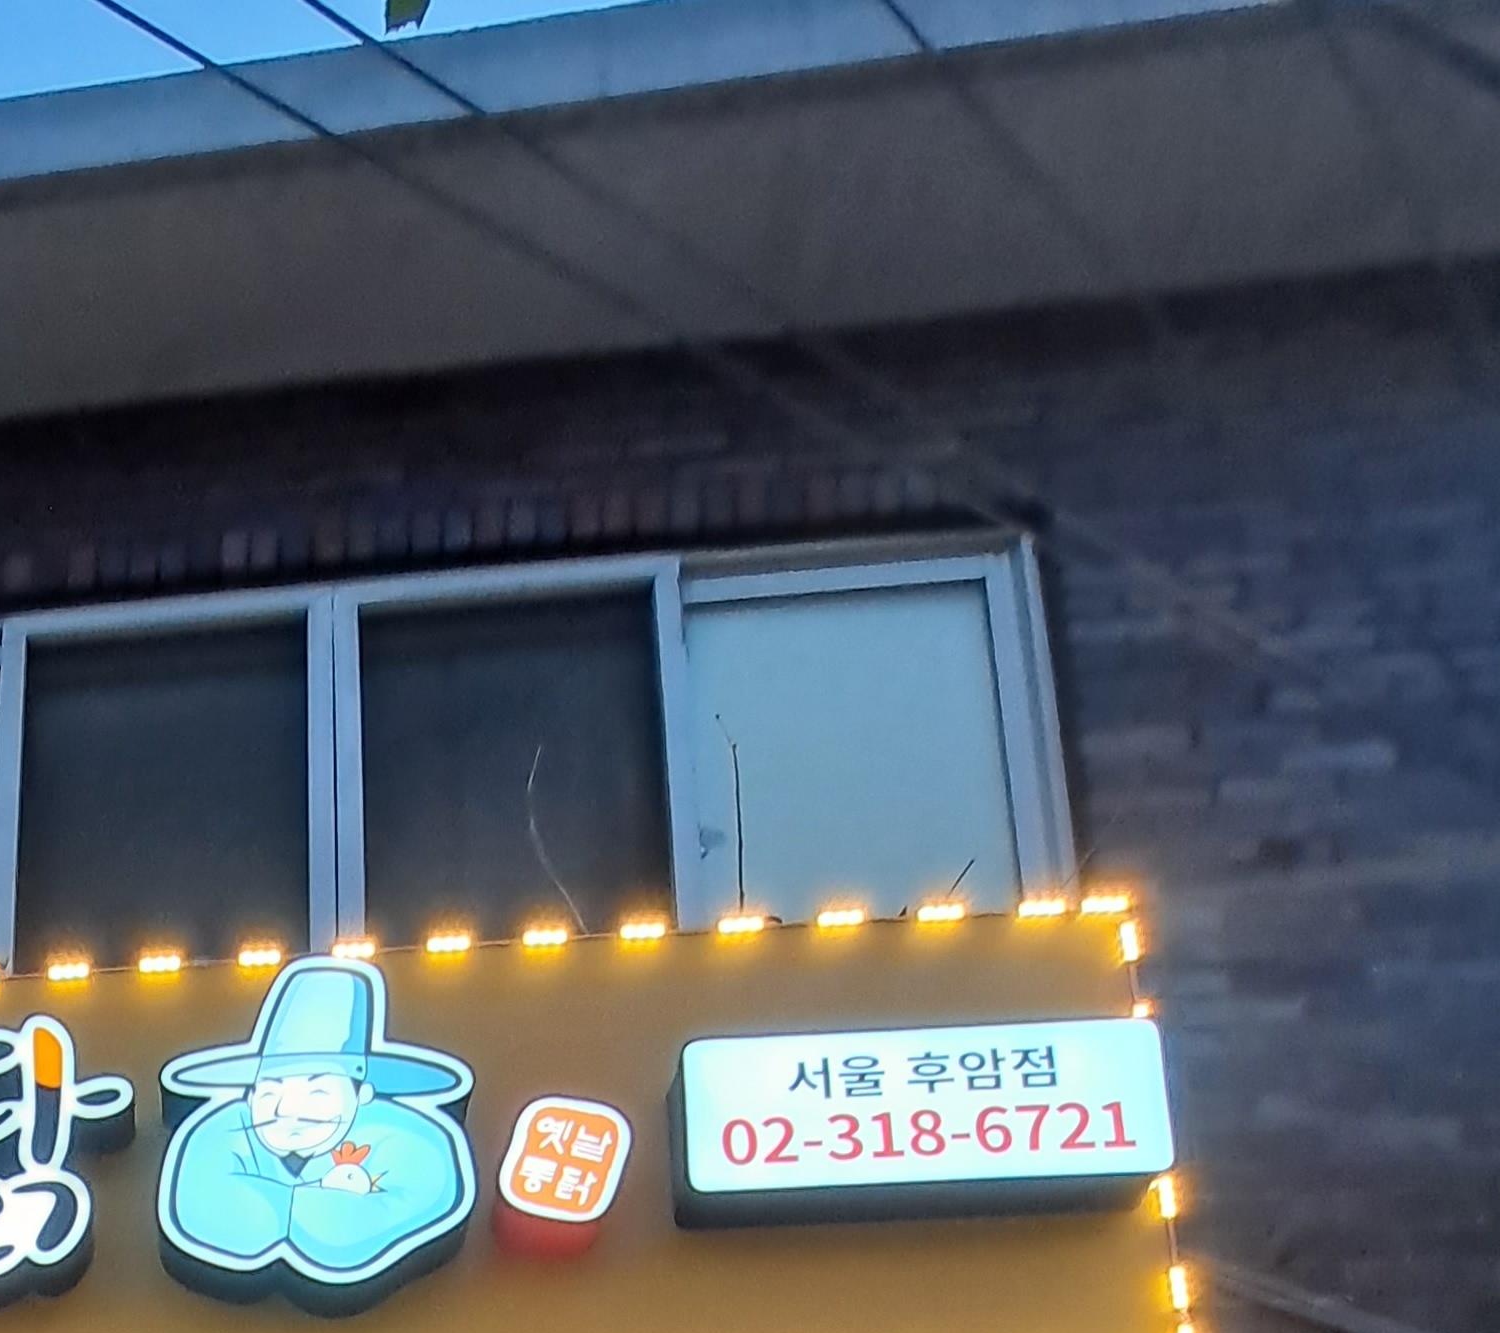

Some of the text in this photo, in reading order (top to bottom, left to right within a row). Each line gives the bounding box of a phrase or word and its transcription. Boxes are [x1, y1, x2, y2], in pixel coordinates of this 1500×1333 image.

[789, 1044, 1058, 1100] 서울 후암점
[536, 1116, 612, 1163] 옛날
[721, 1099, 1137, 1168] 02-318-6721
[519, 1154, 598, 1206] 통닭
